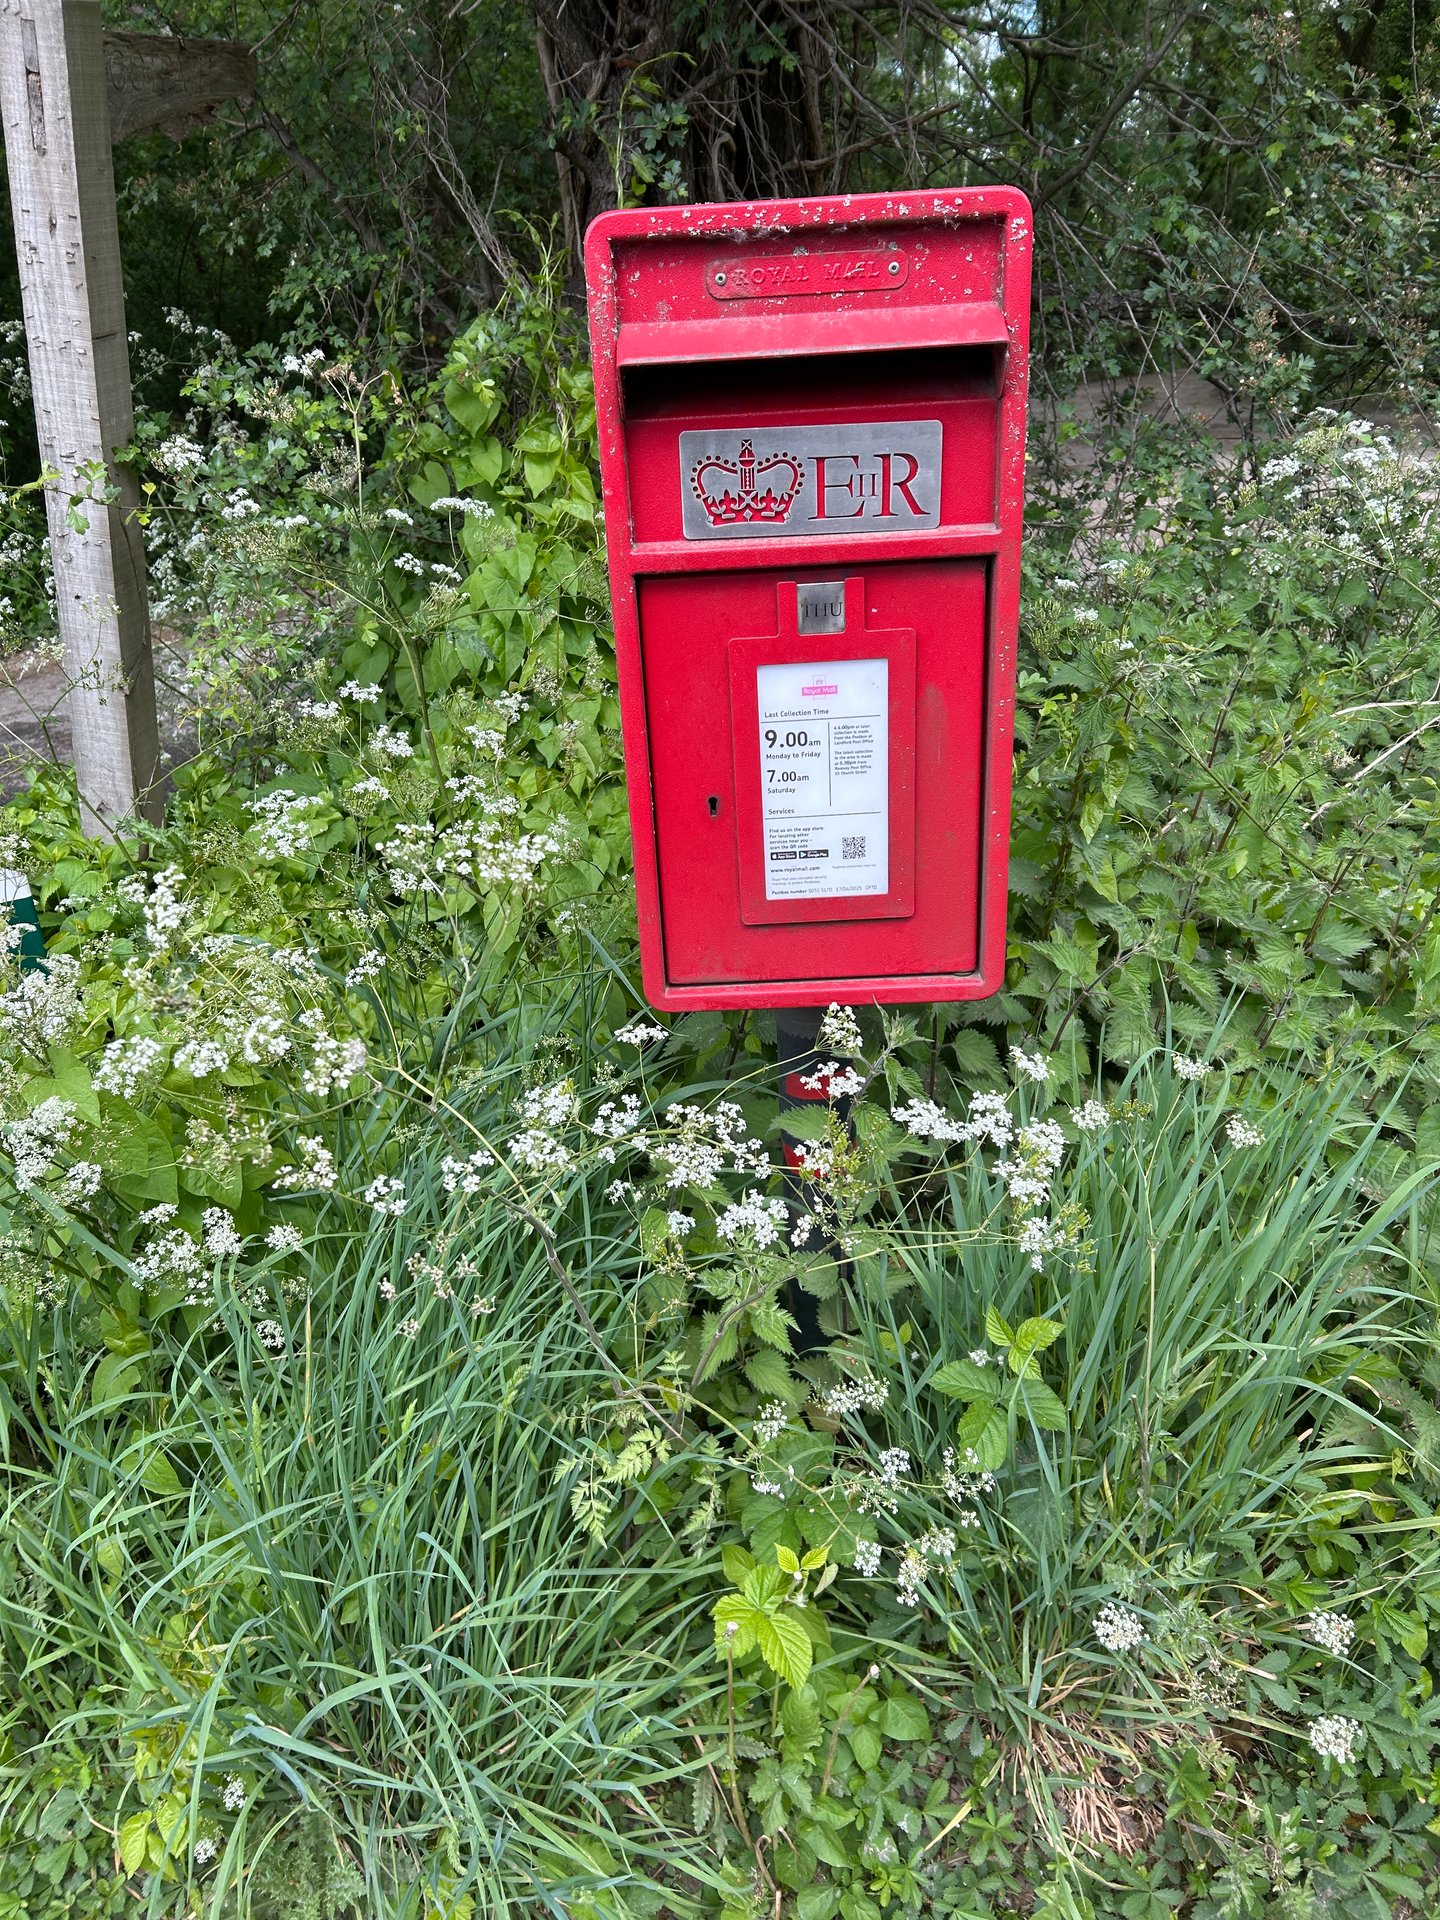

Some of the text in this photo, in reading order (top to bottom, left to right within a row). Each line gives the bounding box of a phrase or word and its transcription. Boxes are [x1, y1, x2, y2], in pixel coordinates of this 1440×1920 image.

[733, 261, 880, 287] ROYAL MAIL
[802, 601, 843, 618] THU
[803, 686, 836, 695] Royal Mail
[780, 709, 811, 717] Collection
[766, 752, 791, 760] Monday
[767, 769, 809, 783] 7.00am
